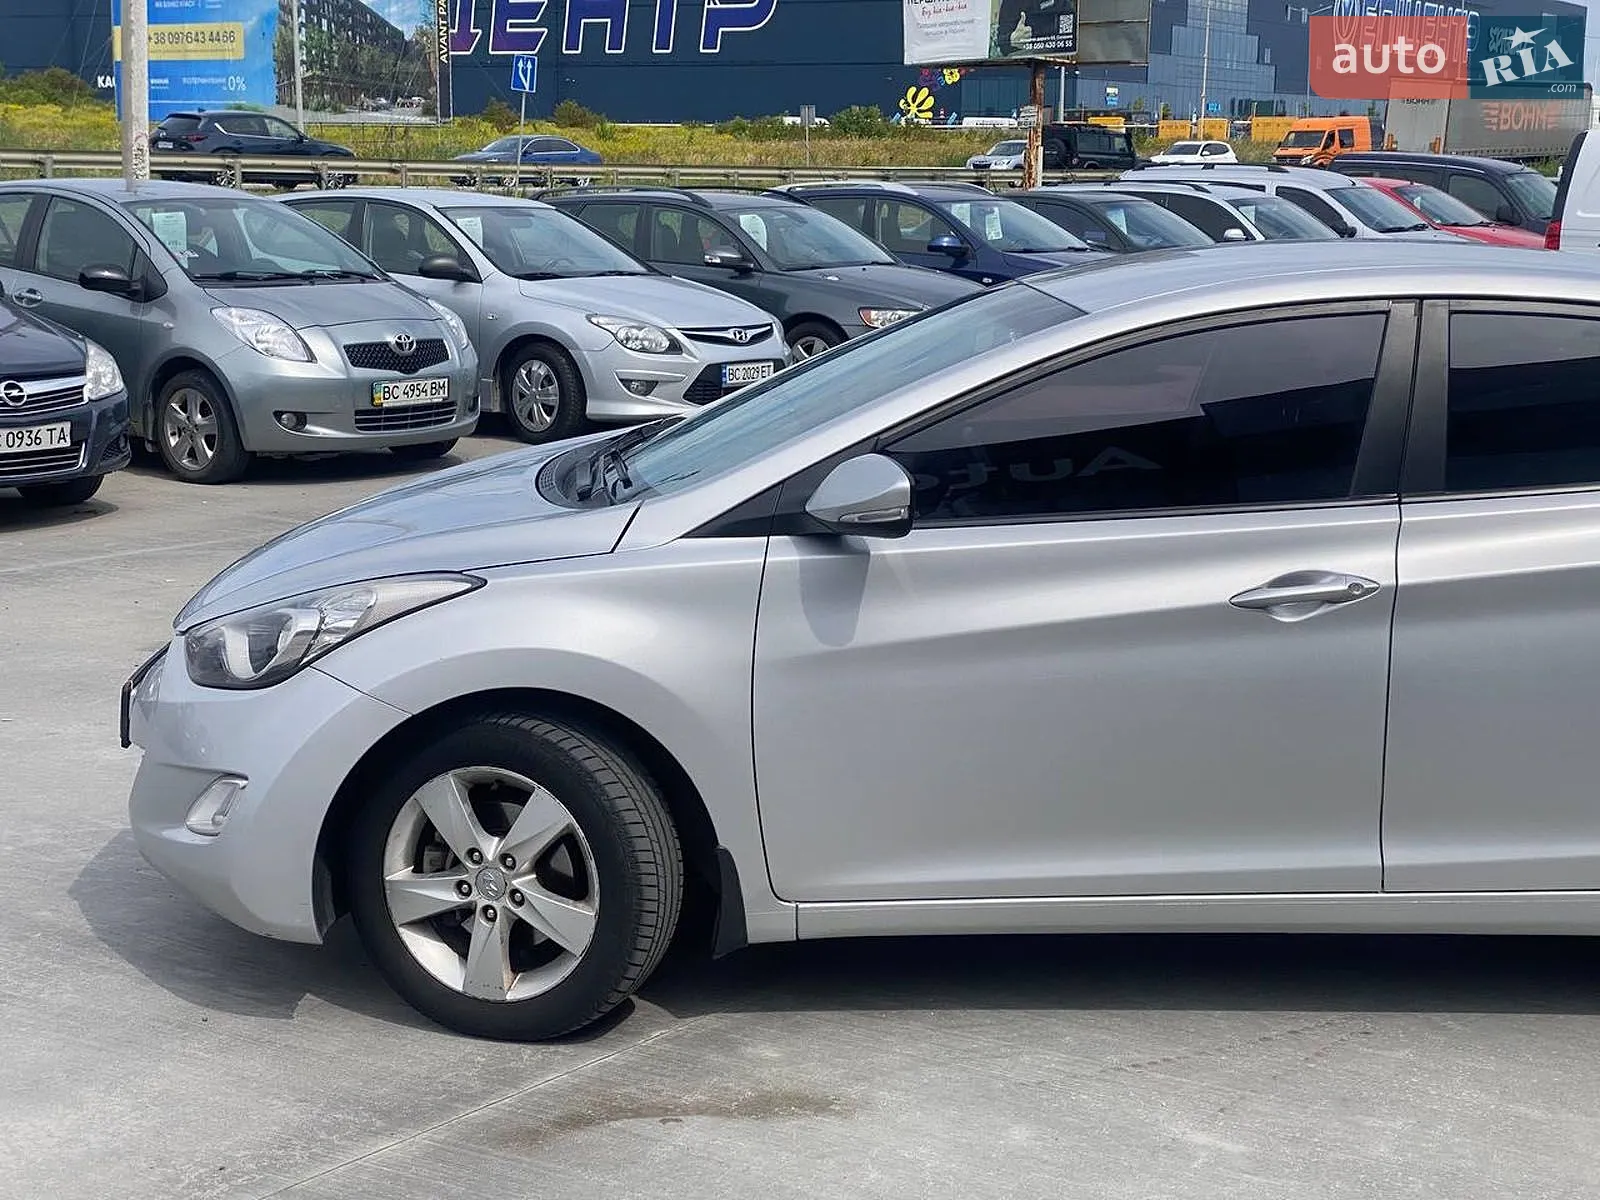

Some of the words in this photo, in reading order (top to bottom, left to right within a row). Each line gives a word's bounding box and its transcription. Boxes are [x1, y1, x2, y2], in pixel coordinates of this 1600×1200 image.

[438, 17, 449, 64] AVANT
[728, 367, 741, 381] BC
[383, 385, 400, 400] BC
[402, 382, 428, 399] 4954
[430, 381, 446, 396] BM
[6, 428, 42, 448] 0936
[46, 427, 67, 445] TA
